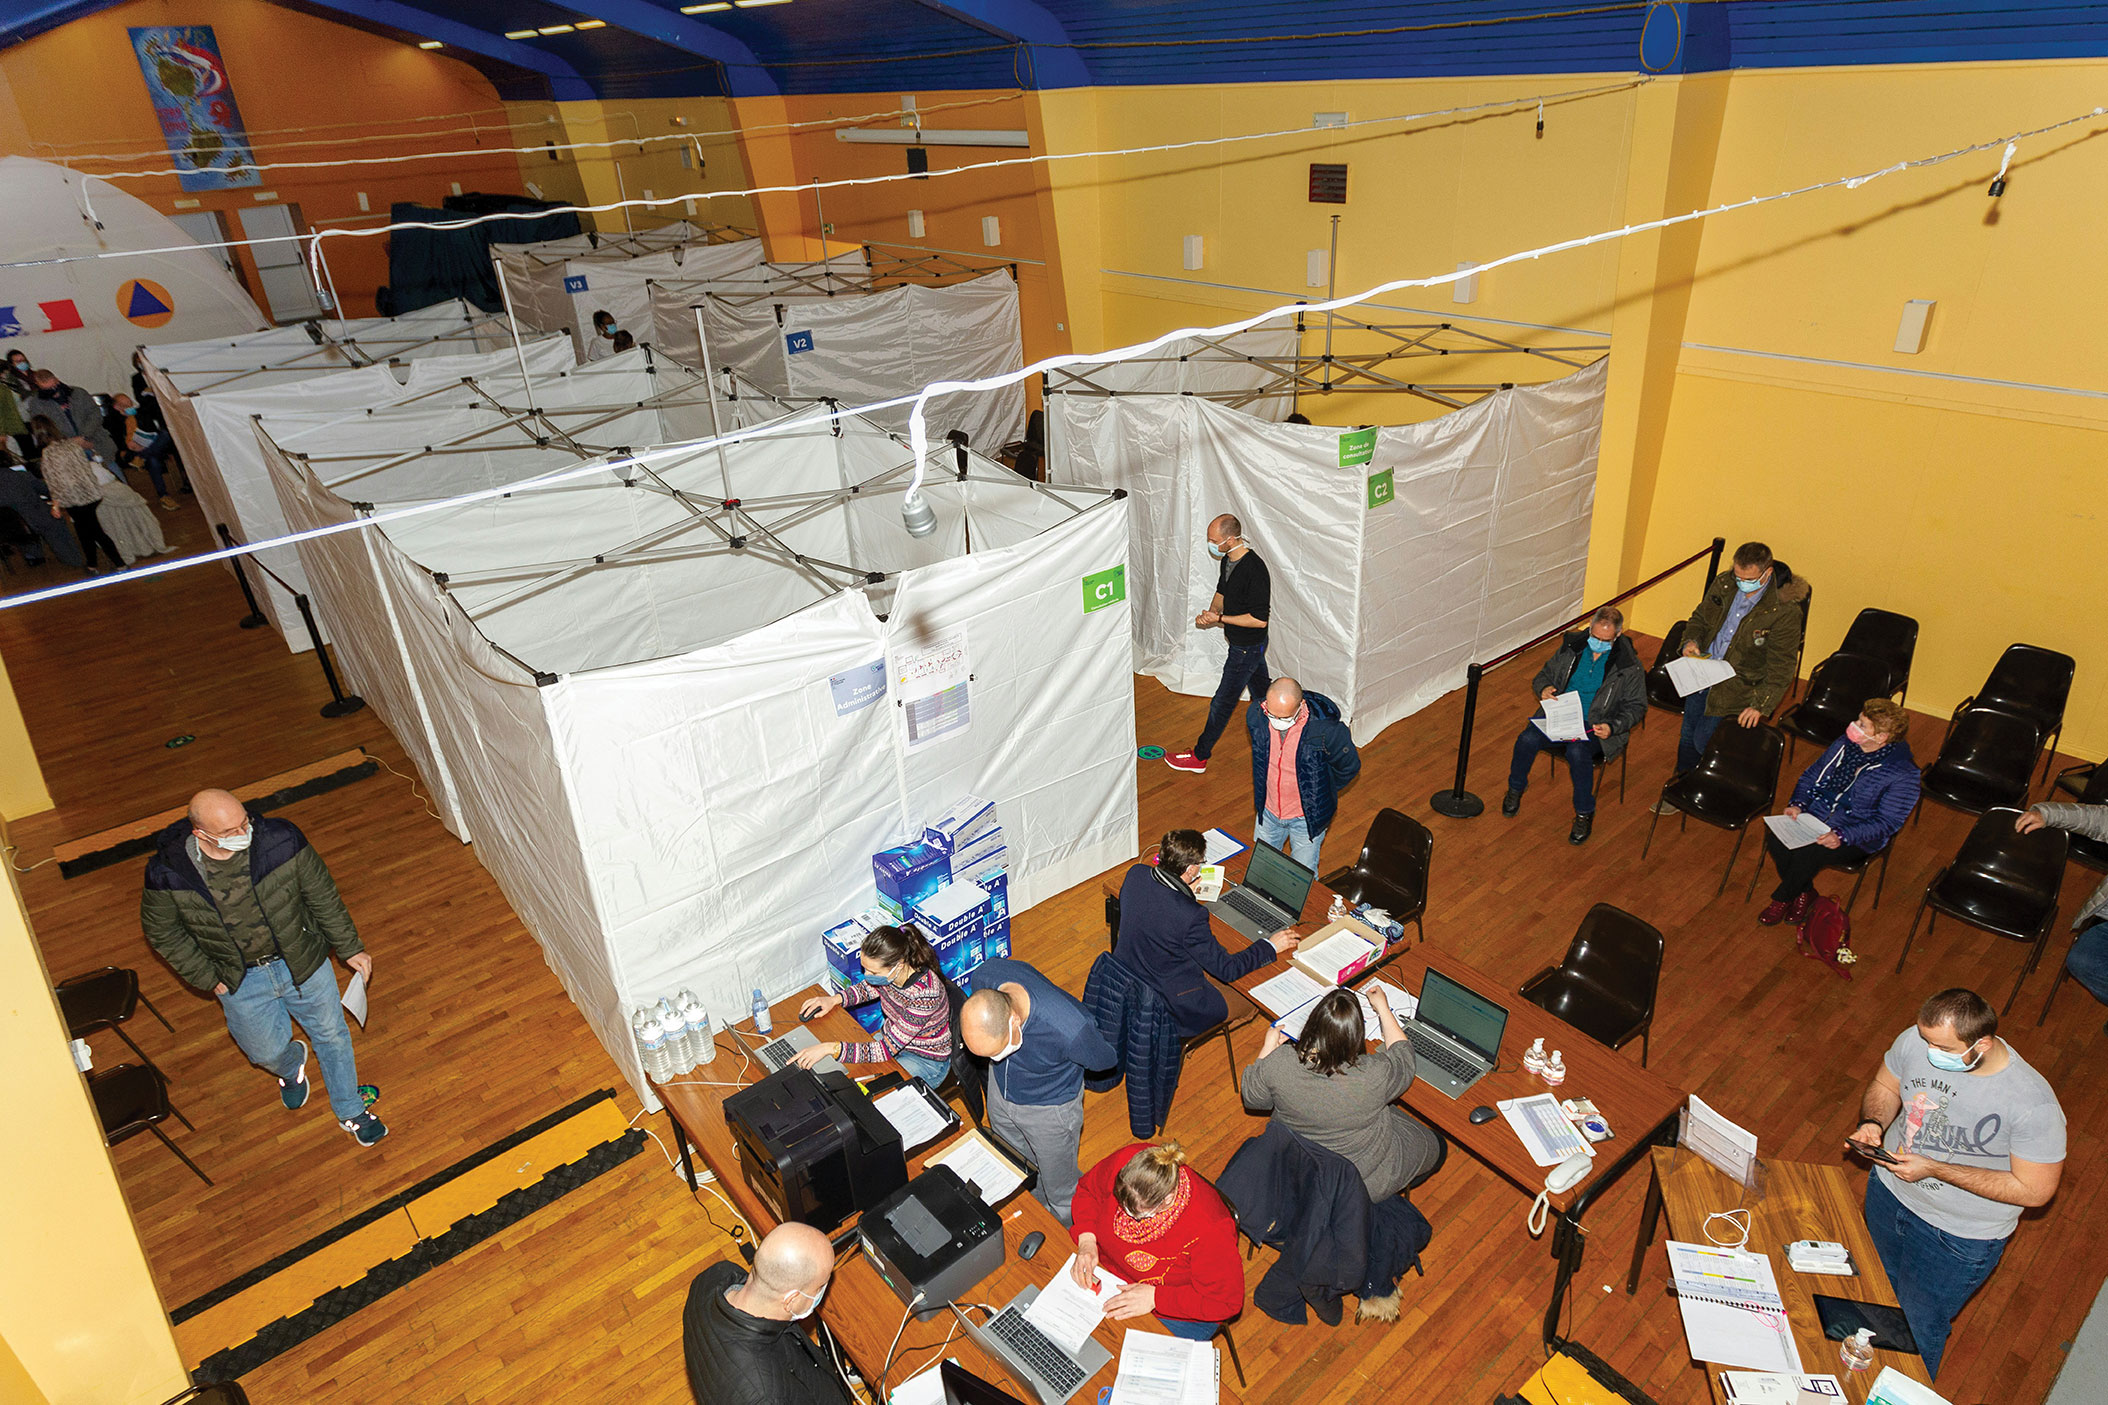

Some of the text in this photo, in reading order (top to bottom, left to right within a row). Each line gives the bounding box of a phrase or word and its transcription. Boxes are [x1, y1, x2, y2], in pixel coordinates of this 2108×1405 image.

[569, 280, 583, 290] V3
[793, 338, 807, 349] V2
[1374, 482, 1388, 499] C2
[1095, 581, 1114, 600] C1
[836, 685, 886, 711] Administrative
[852, 684, 872, 696] Zone
[948, 906, 984, 932] Double A
[940, 930, 969, 951] Double
[970, 924, 977, 934] A
[1911, 1078, 1951, 1094] THE MAN
